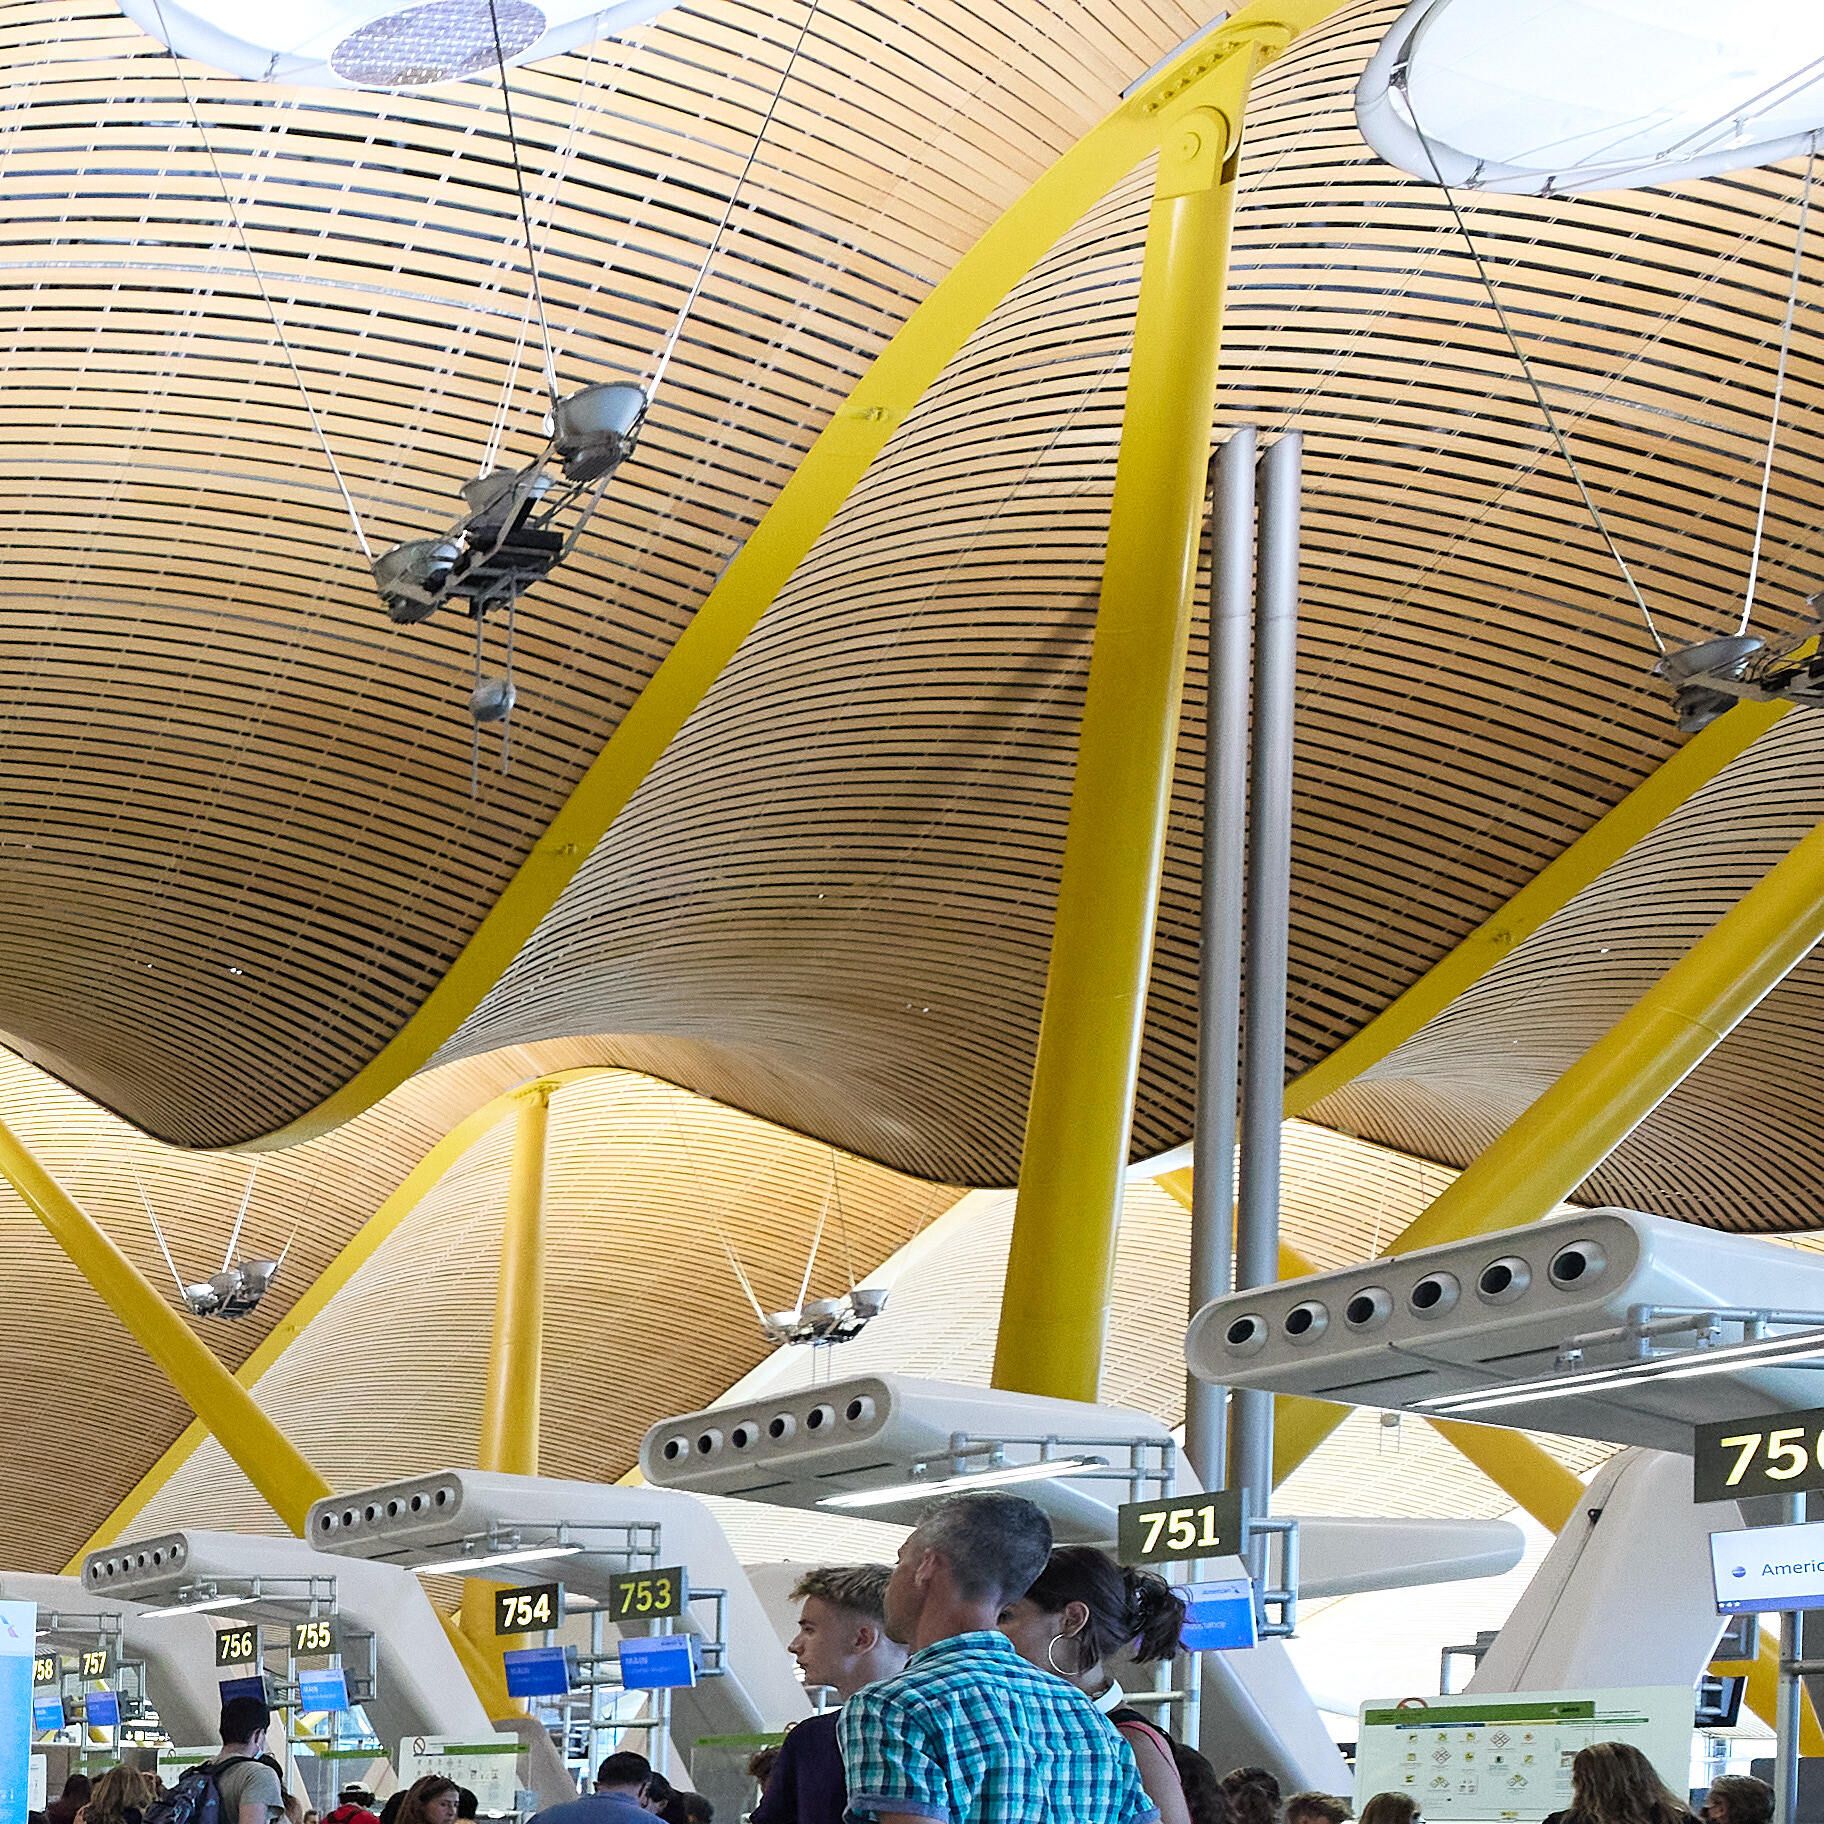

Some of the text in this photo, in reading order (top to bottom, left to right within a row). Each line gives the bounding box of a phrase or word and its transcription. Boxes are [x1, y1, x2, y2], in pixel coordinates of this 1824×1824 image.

[1720, 1427, 1824, 1486] 75
[1139, 1505, 1220, 1554] 751
[1762, 1559, 1824, 1577] Americ
[502, 1593, 551, 1628] 754
[619, 1578, 672, 1614] 753
[220, 1632, 253, 1659] 756
[296, 1621, 331, 1650] 755
[83, 1651, 106, 1675] 757
